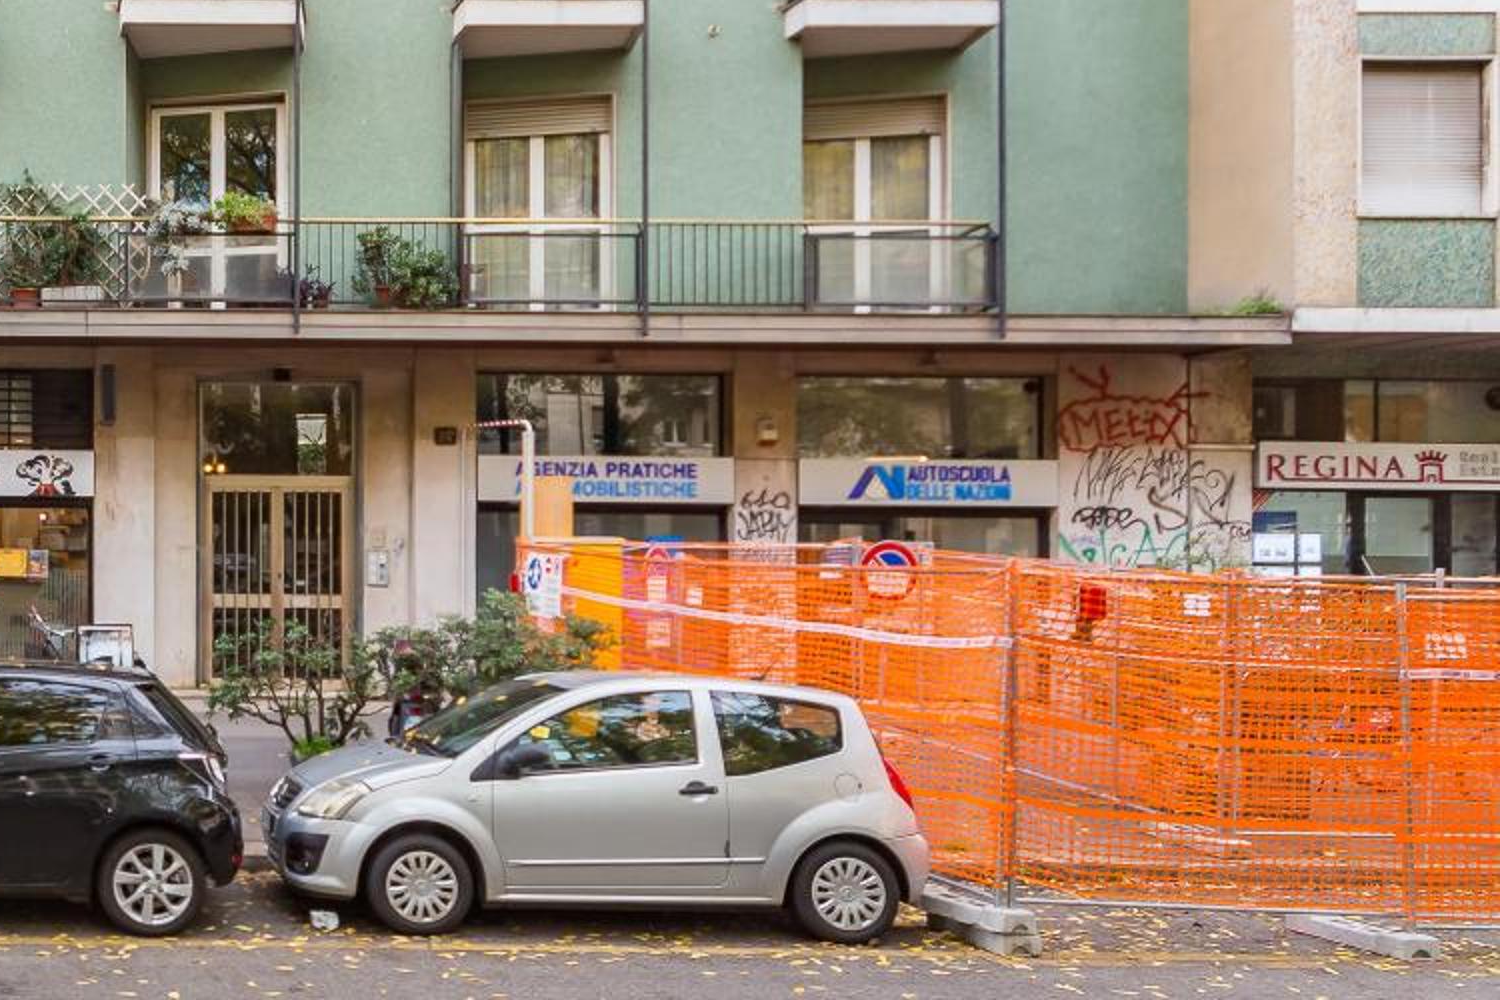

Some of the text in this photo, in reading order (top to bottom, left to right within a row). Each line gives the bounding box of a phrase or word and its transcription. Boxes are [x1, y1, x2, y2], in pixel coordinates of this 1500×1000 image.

[605, 462, 697, 477] PRATICHE
[907, 465, 1010, 482] AUTOSCUOLA
[1266, 454, 1404, 481] REGINA
[908, 484, 950, 500] DELLE
